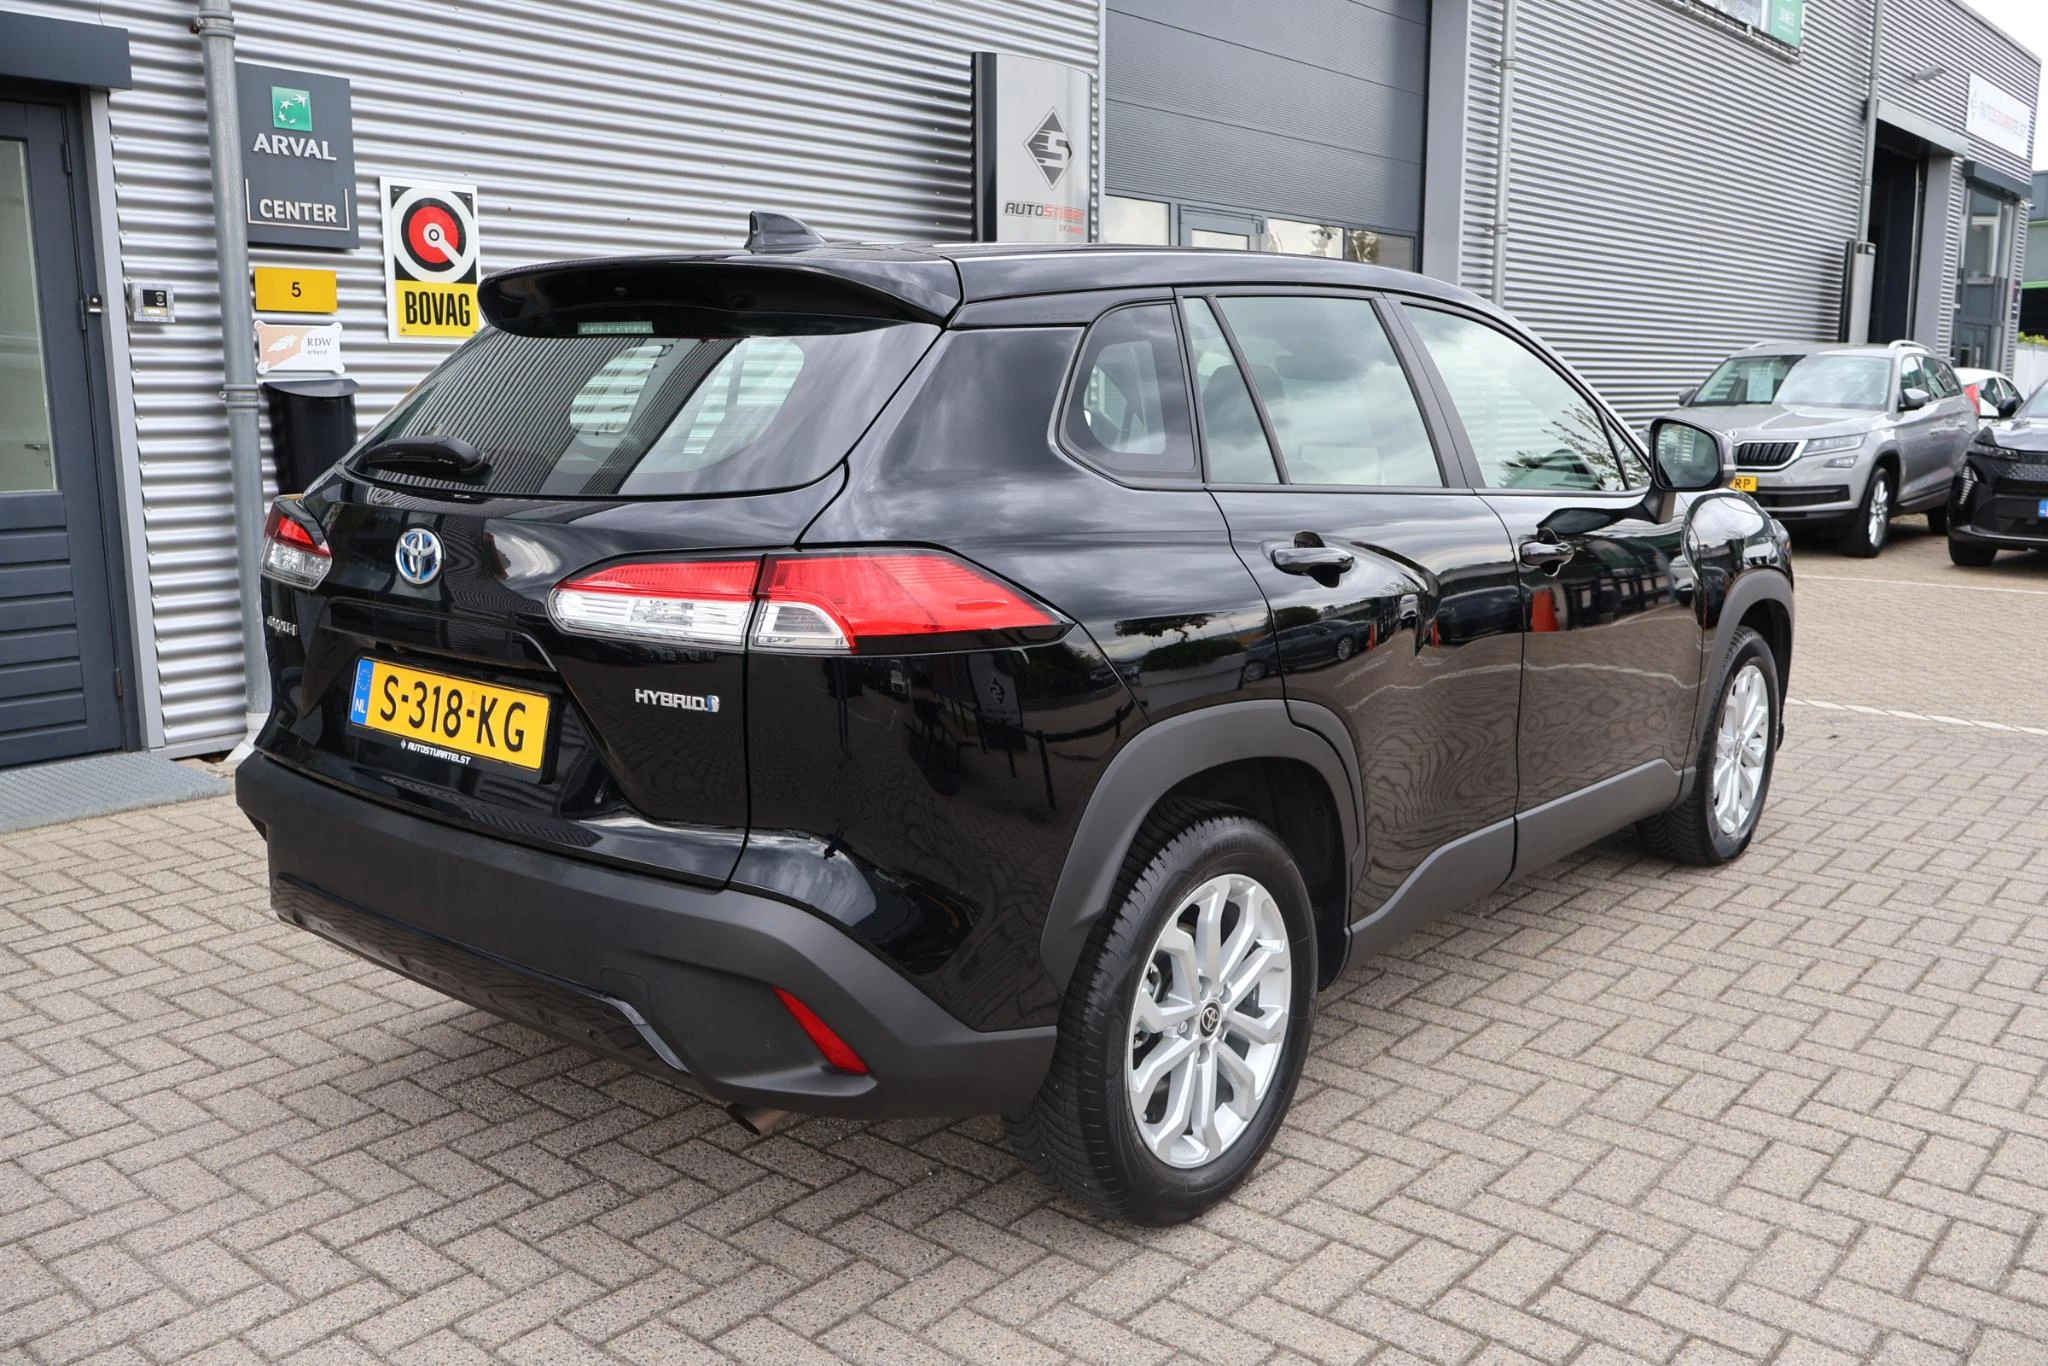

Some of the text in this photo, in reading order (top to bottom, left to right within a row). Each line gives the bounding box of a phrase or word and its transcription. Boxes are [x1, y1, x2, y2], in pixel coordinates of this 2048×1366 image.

[252, 133, 337, 161] ARVAL
[259, 199, 337, 223] CENTER
[291, 282, 301, 297] 5
[404, 290, 471, 326] BOVAG
[307, 336, 332, 347] RDW
[634, 688, 706, 711] HYBRID
[354, 674, 527, 753] NL S-318-KG
